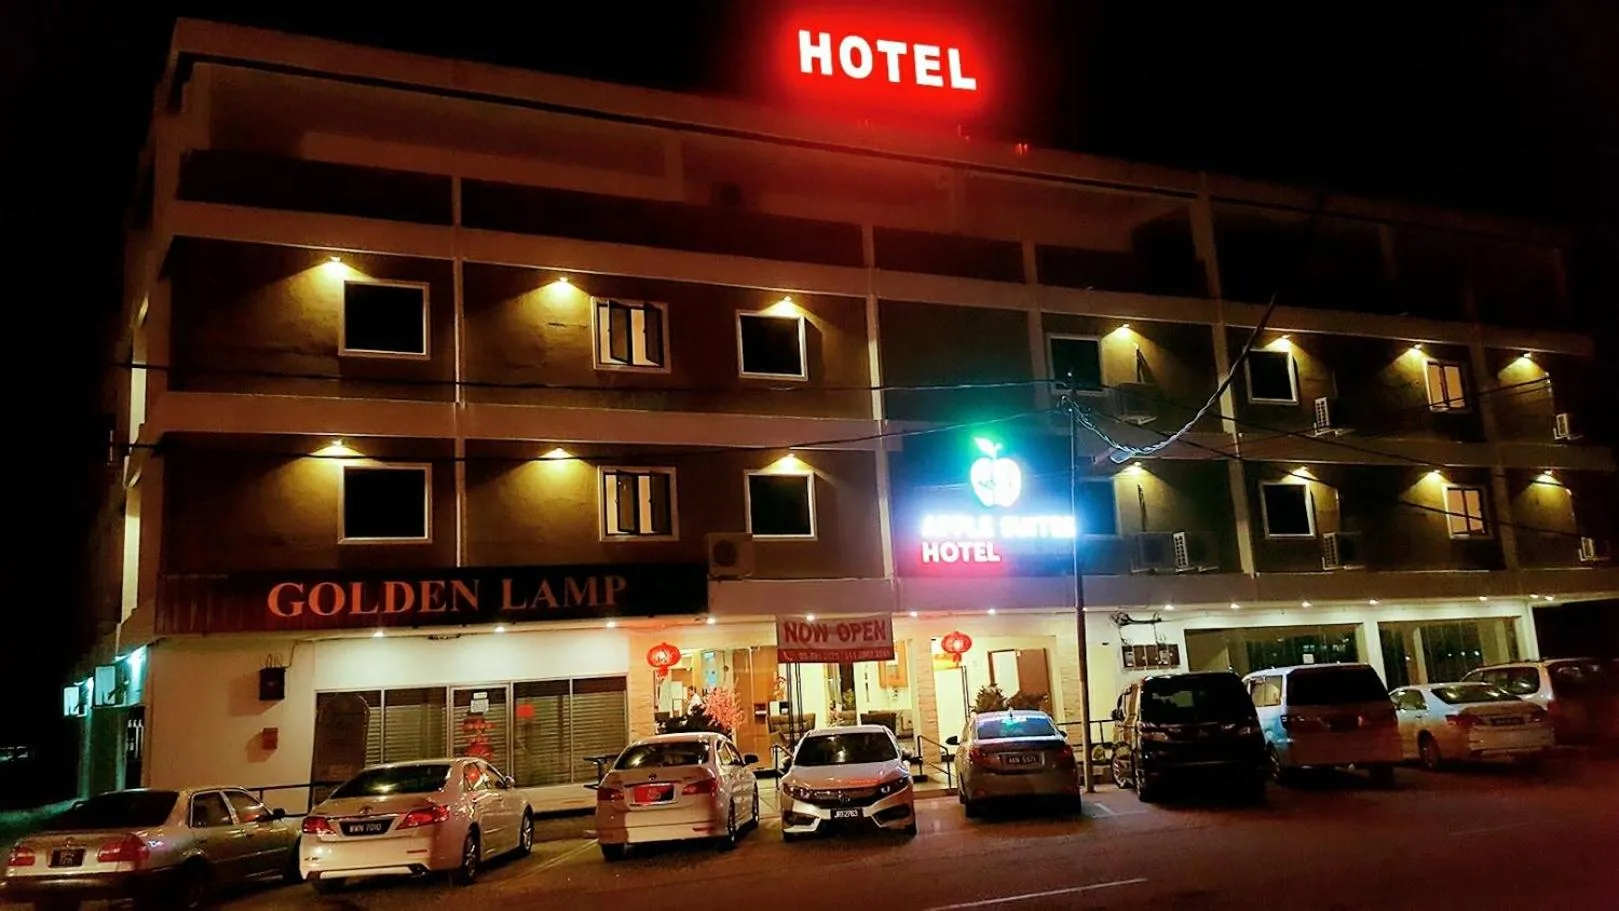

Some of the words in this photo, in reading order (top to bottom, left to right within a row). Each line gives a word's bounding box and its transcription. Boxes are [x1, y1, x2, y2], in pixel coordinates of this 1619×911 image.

[798, 29, 977, 91] HOTEL
[922, 541, 1001, 563] HOTEL
[266, 579, 481, 618] GOLDEN
[501, 575, 628, 611] LAMP
[783, 620, 830, 644] NOW
[836, 620, 887, 642] OPEN
